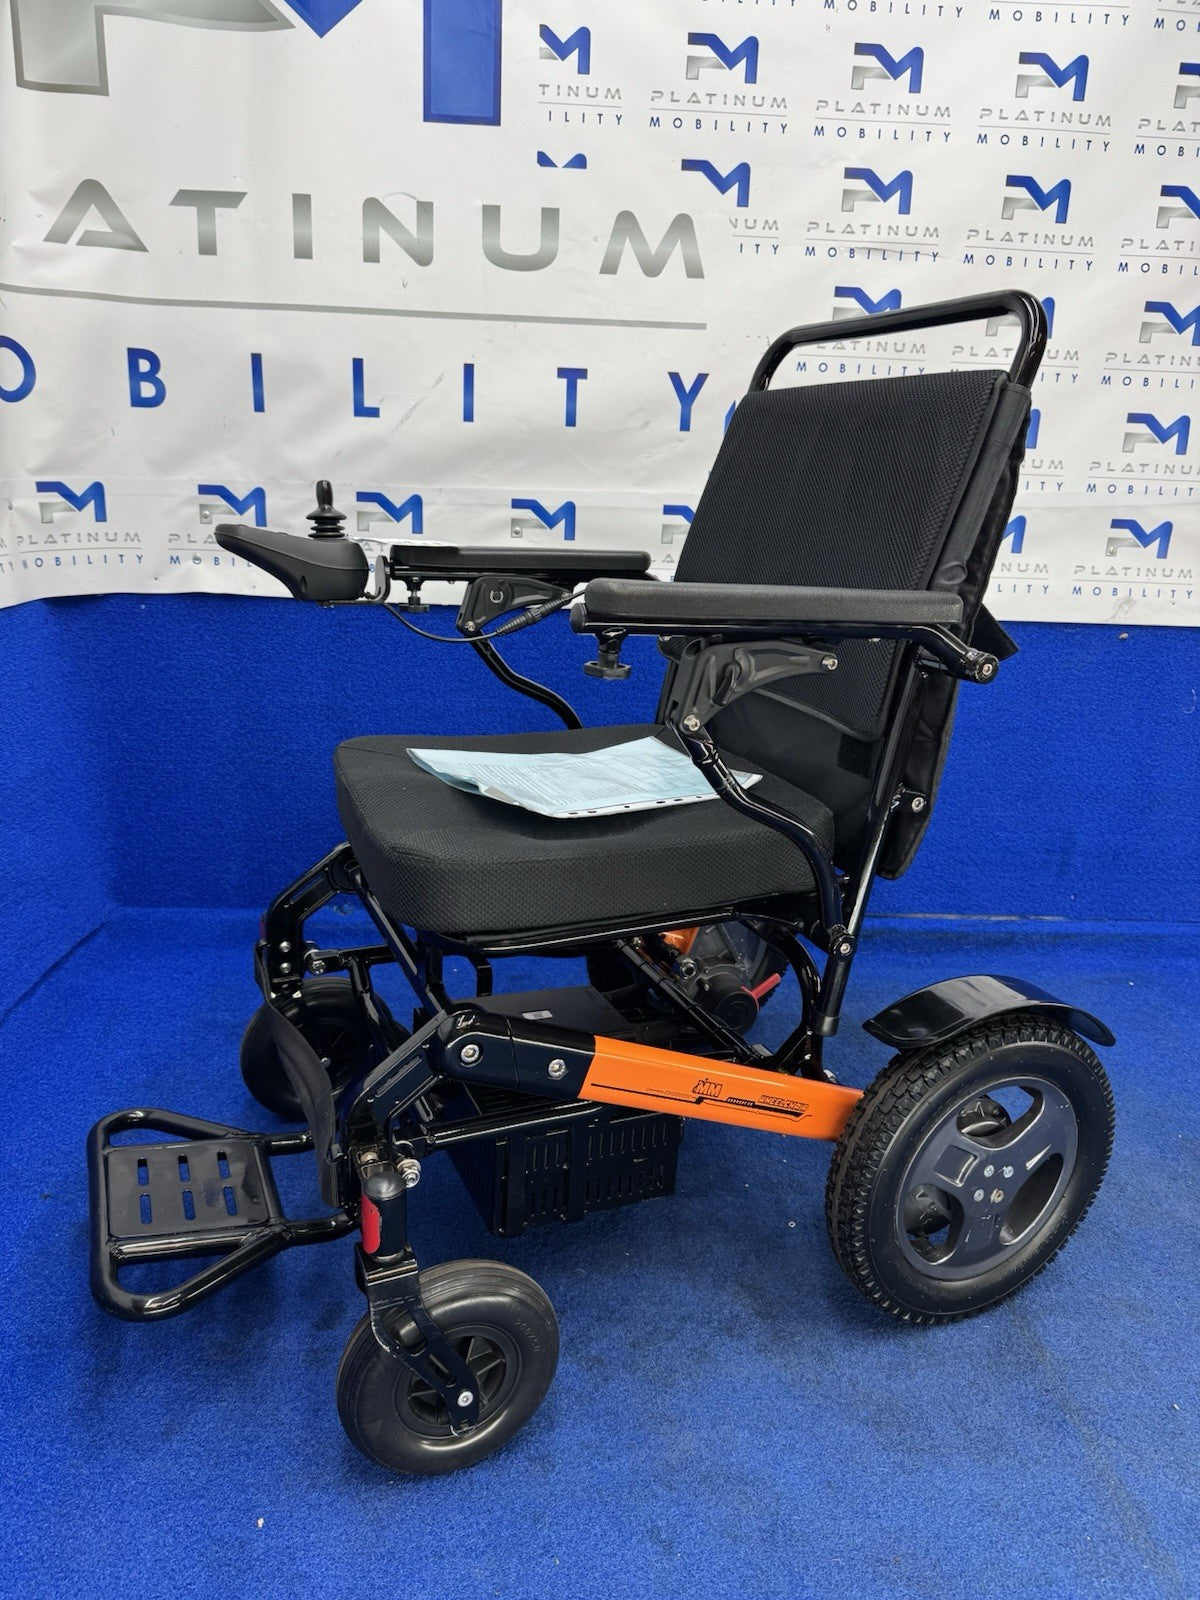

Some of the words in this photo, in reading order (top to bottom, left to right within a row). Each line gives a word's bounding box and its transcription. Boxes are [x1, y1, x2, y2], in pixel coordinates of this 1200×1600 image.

[823, 0, 963, 18] MOBILITY
[989, 9, 1129, 26] MOBILITY
[651, 90, 788, 109] PLATINUM
[816, 100, 951, 119] PLATINUM
[979, 107, 1111, 127] PLATINUM
[650, 116, 788, 134] MOBILITY
[814, 125, 951, 143] MOBILITY
[977, 133, 1110, 152] MOBILITY
[43, 178, 705, 279] ATINUM
[806, 221, 940, 238] PLATINUM
[966, 229, 1095, 247] PLATINUM
[804, 246, 939, 262] MOBILITY
[963, 254, 1093, 271] MOBILITY
[796, 361, 925, 375] MOBILITY
[16, 532, 141, 547] PLATINUM
[22, 554, 143, 569] MOBILITY
[1073, 565, 1193, 579] PLATINUM
[1072, 586, 1193, 600] MOBILITY
